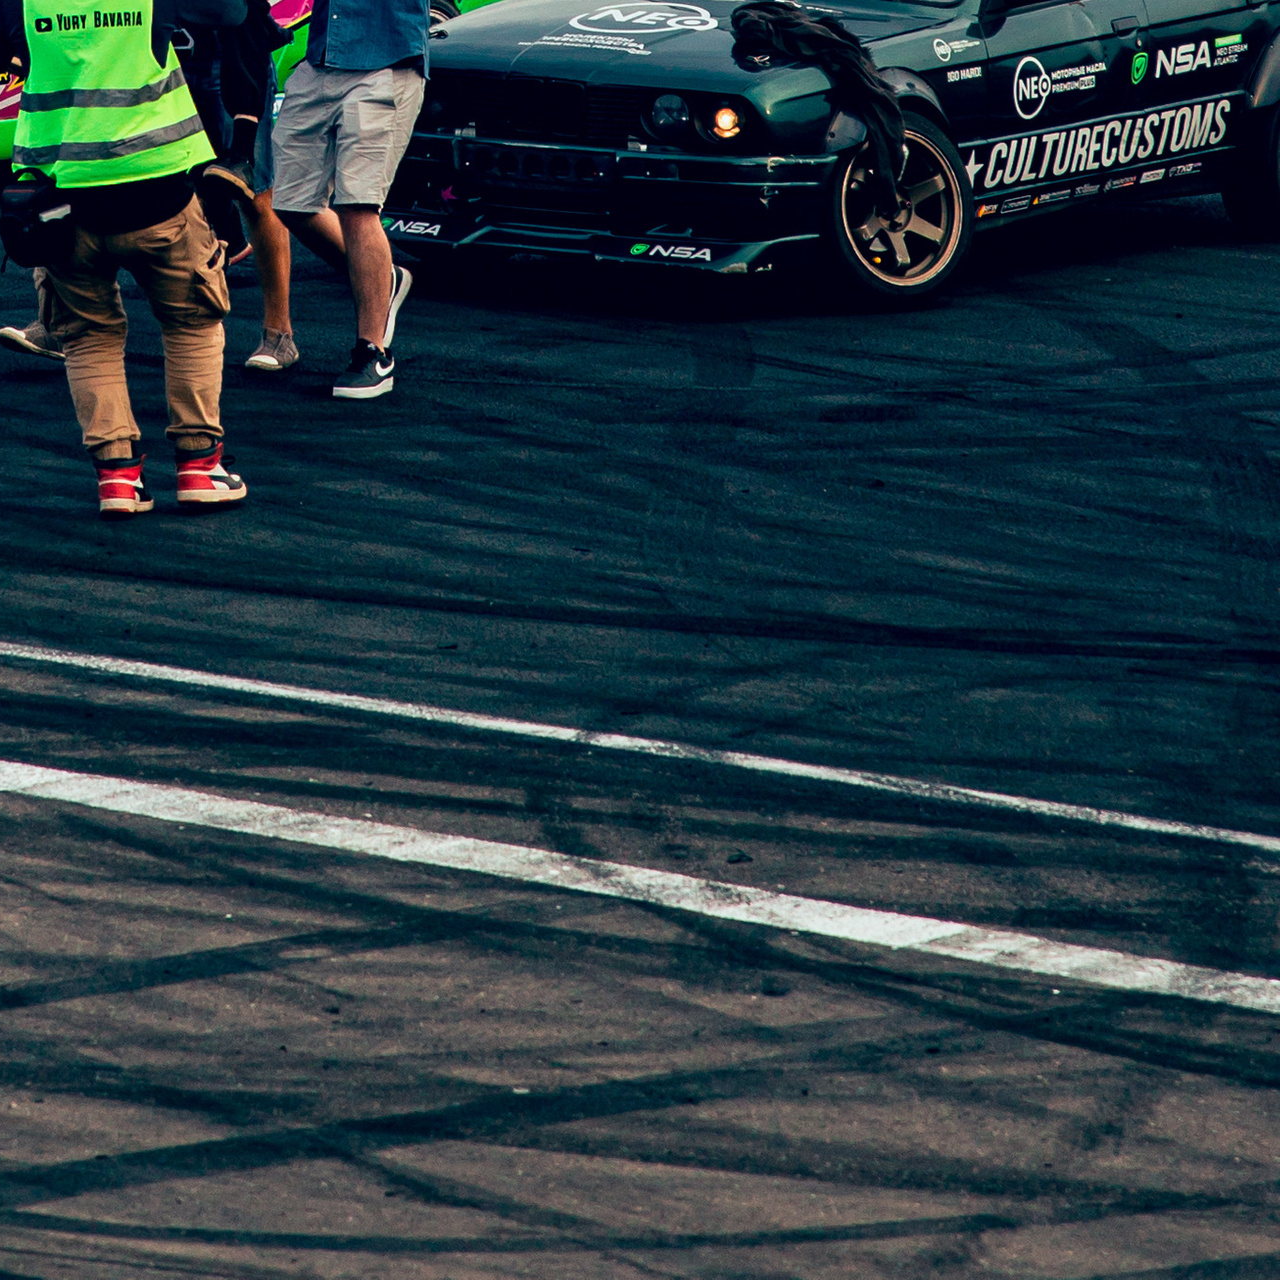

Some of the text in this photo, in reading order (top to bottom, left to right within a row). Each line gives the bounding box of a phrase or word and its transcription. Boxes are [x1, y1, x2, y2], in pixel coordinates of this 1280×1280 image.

[56, 11, 143, 31] YURY BAVARIA
[1154, 41, 1212, 78] NSA
[1051, 62, 1107, 80] МОТОРНЫЕ МАСЛА
[1051, 77, 1095, 93] PREMIUM PLUS
[983, 99, 1231, 189] CULTURECUSTOMS
[390, 219, 442, 237] NSA
[649, 244, 713, 263] NSA
